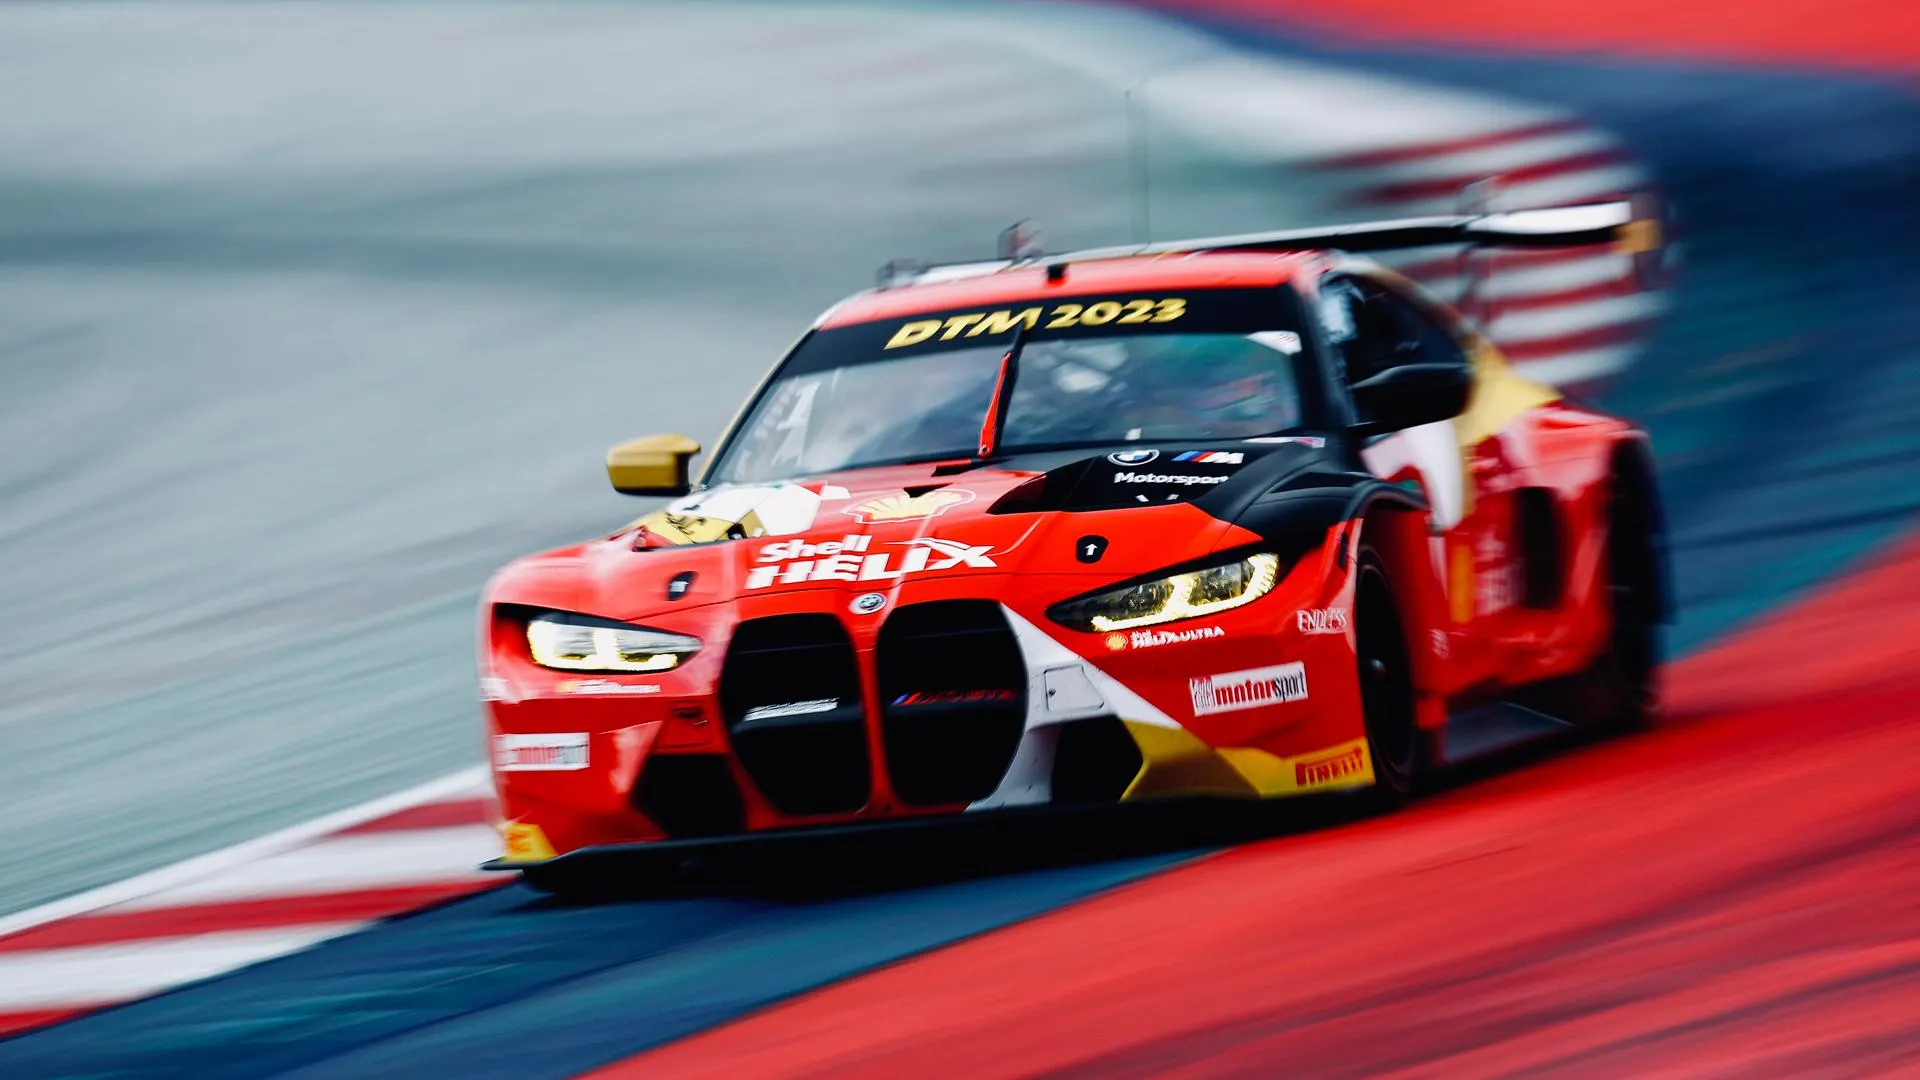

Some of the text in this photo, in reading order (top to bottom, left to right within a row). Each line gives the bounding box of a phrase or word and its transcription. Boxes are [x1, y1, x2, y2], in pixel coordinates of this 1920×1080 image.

[883, 298, 1187, 350] DTM 2023
[743, 538, 998, 590] HELIX
[755, 534, 872, 563] Shell
